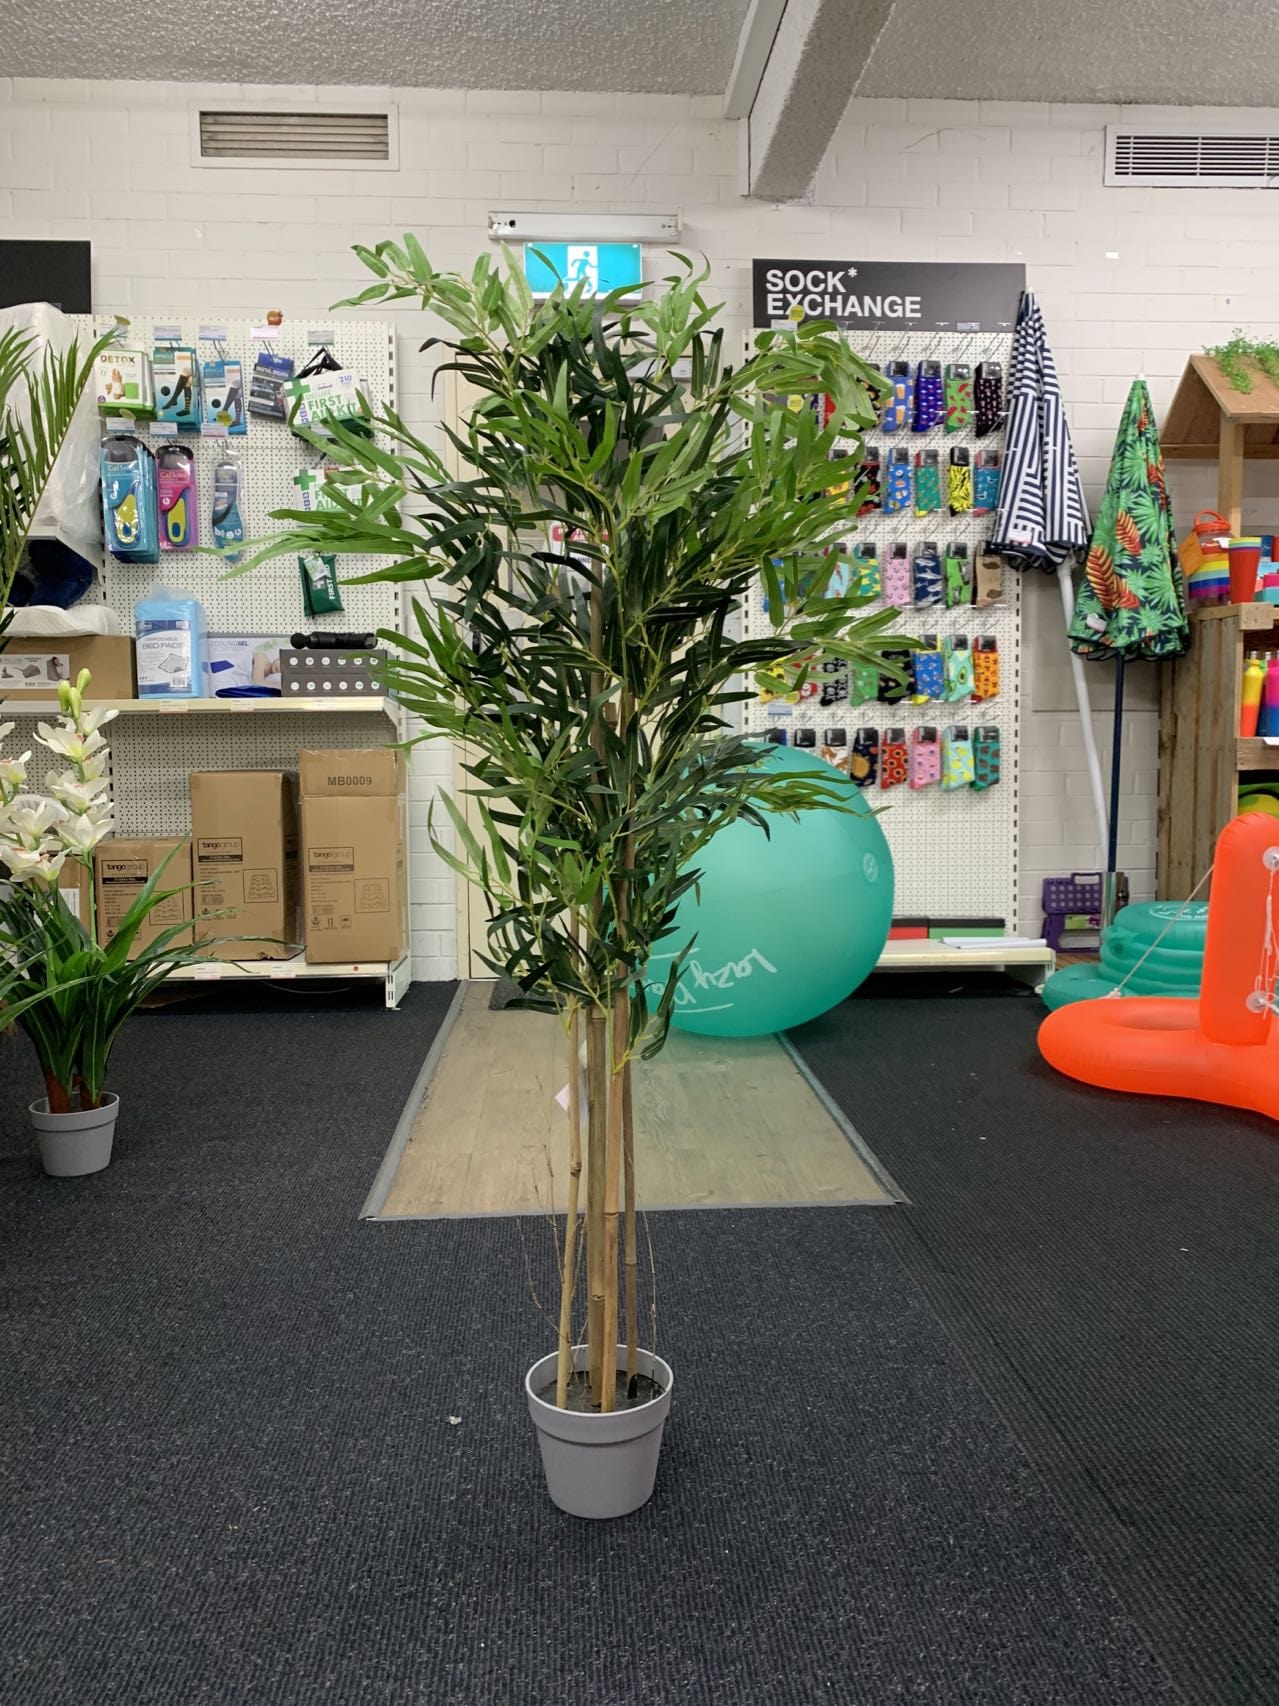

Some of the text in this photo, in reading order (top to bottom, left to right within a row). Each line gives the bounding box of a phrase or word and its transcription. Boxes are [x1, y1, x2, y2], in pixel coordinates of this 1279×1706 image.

[767, 294, 922, 318] EXCHANGE
[100, 354, 136, 364] DETOX
[338, 374, 352, 383] 210
[308, 395, 342, 411] FIRST
[327, 579, 336, 600] FIRST
[327, 776, 373, 786] MB0009
[689, 948, 778, 990] Lazy
